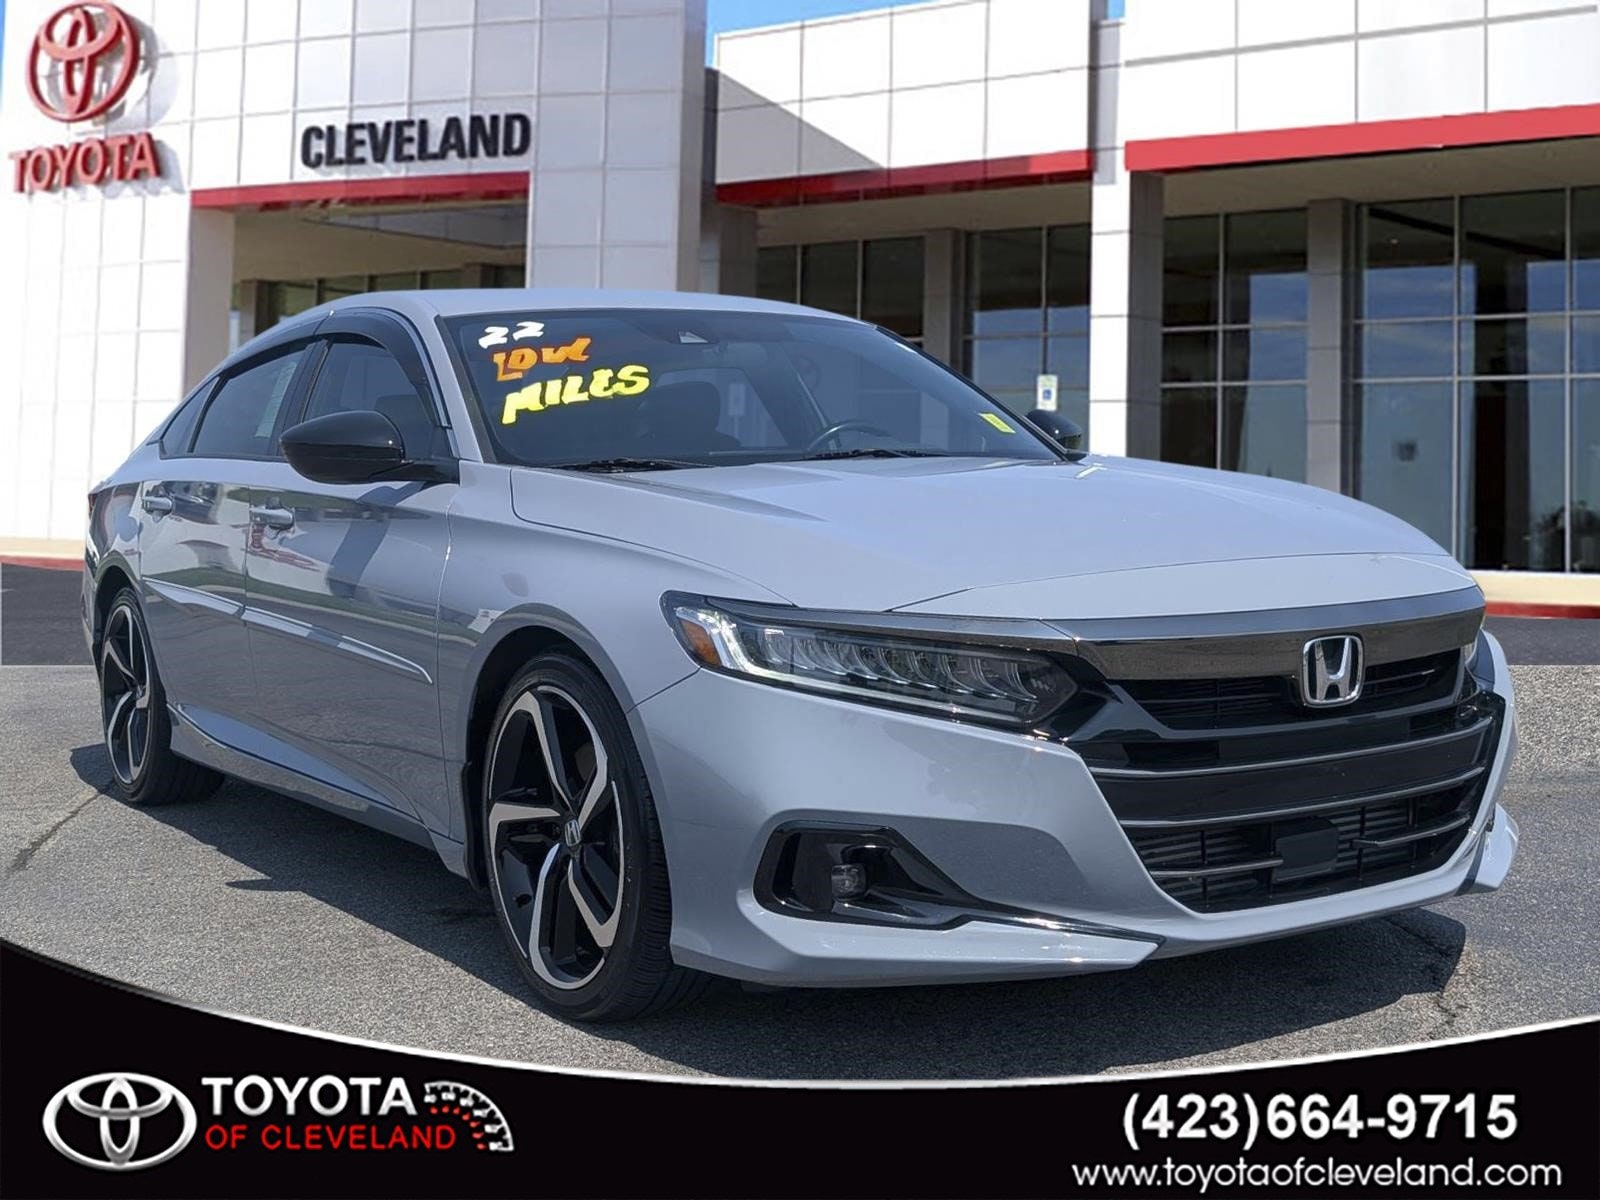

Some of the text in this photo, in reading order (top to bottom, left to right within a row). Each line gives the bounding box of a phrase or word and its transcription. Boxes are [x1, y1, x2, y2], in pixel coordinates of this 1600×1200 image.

[9, 132, 162, 193] TOYOTA
[301, 113, 531, 169] CLEVELAND
[478, 321, 544, 348] 22
